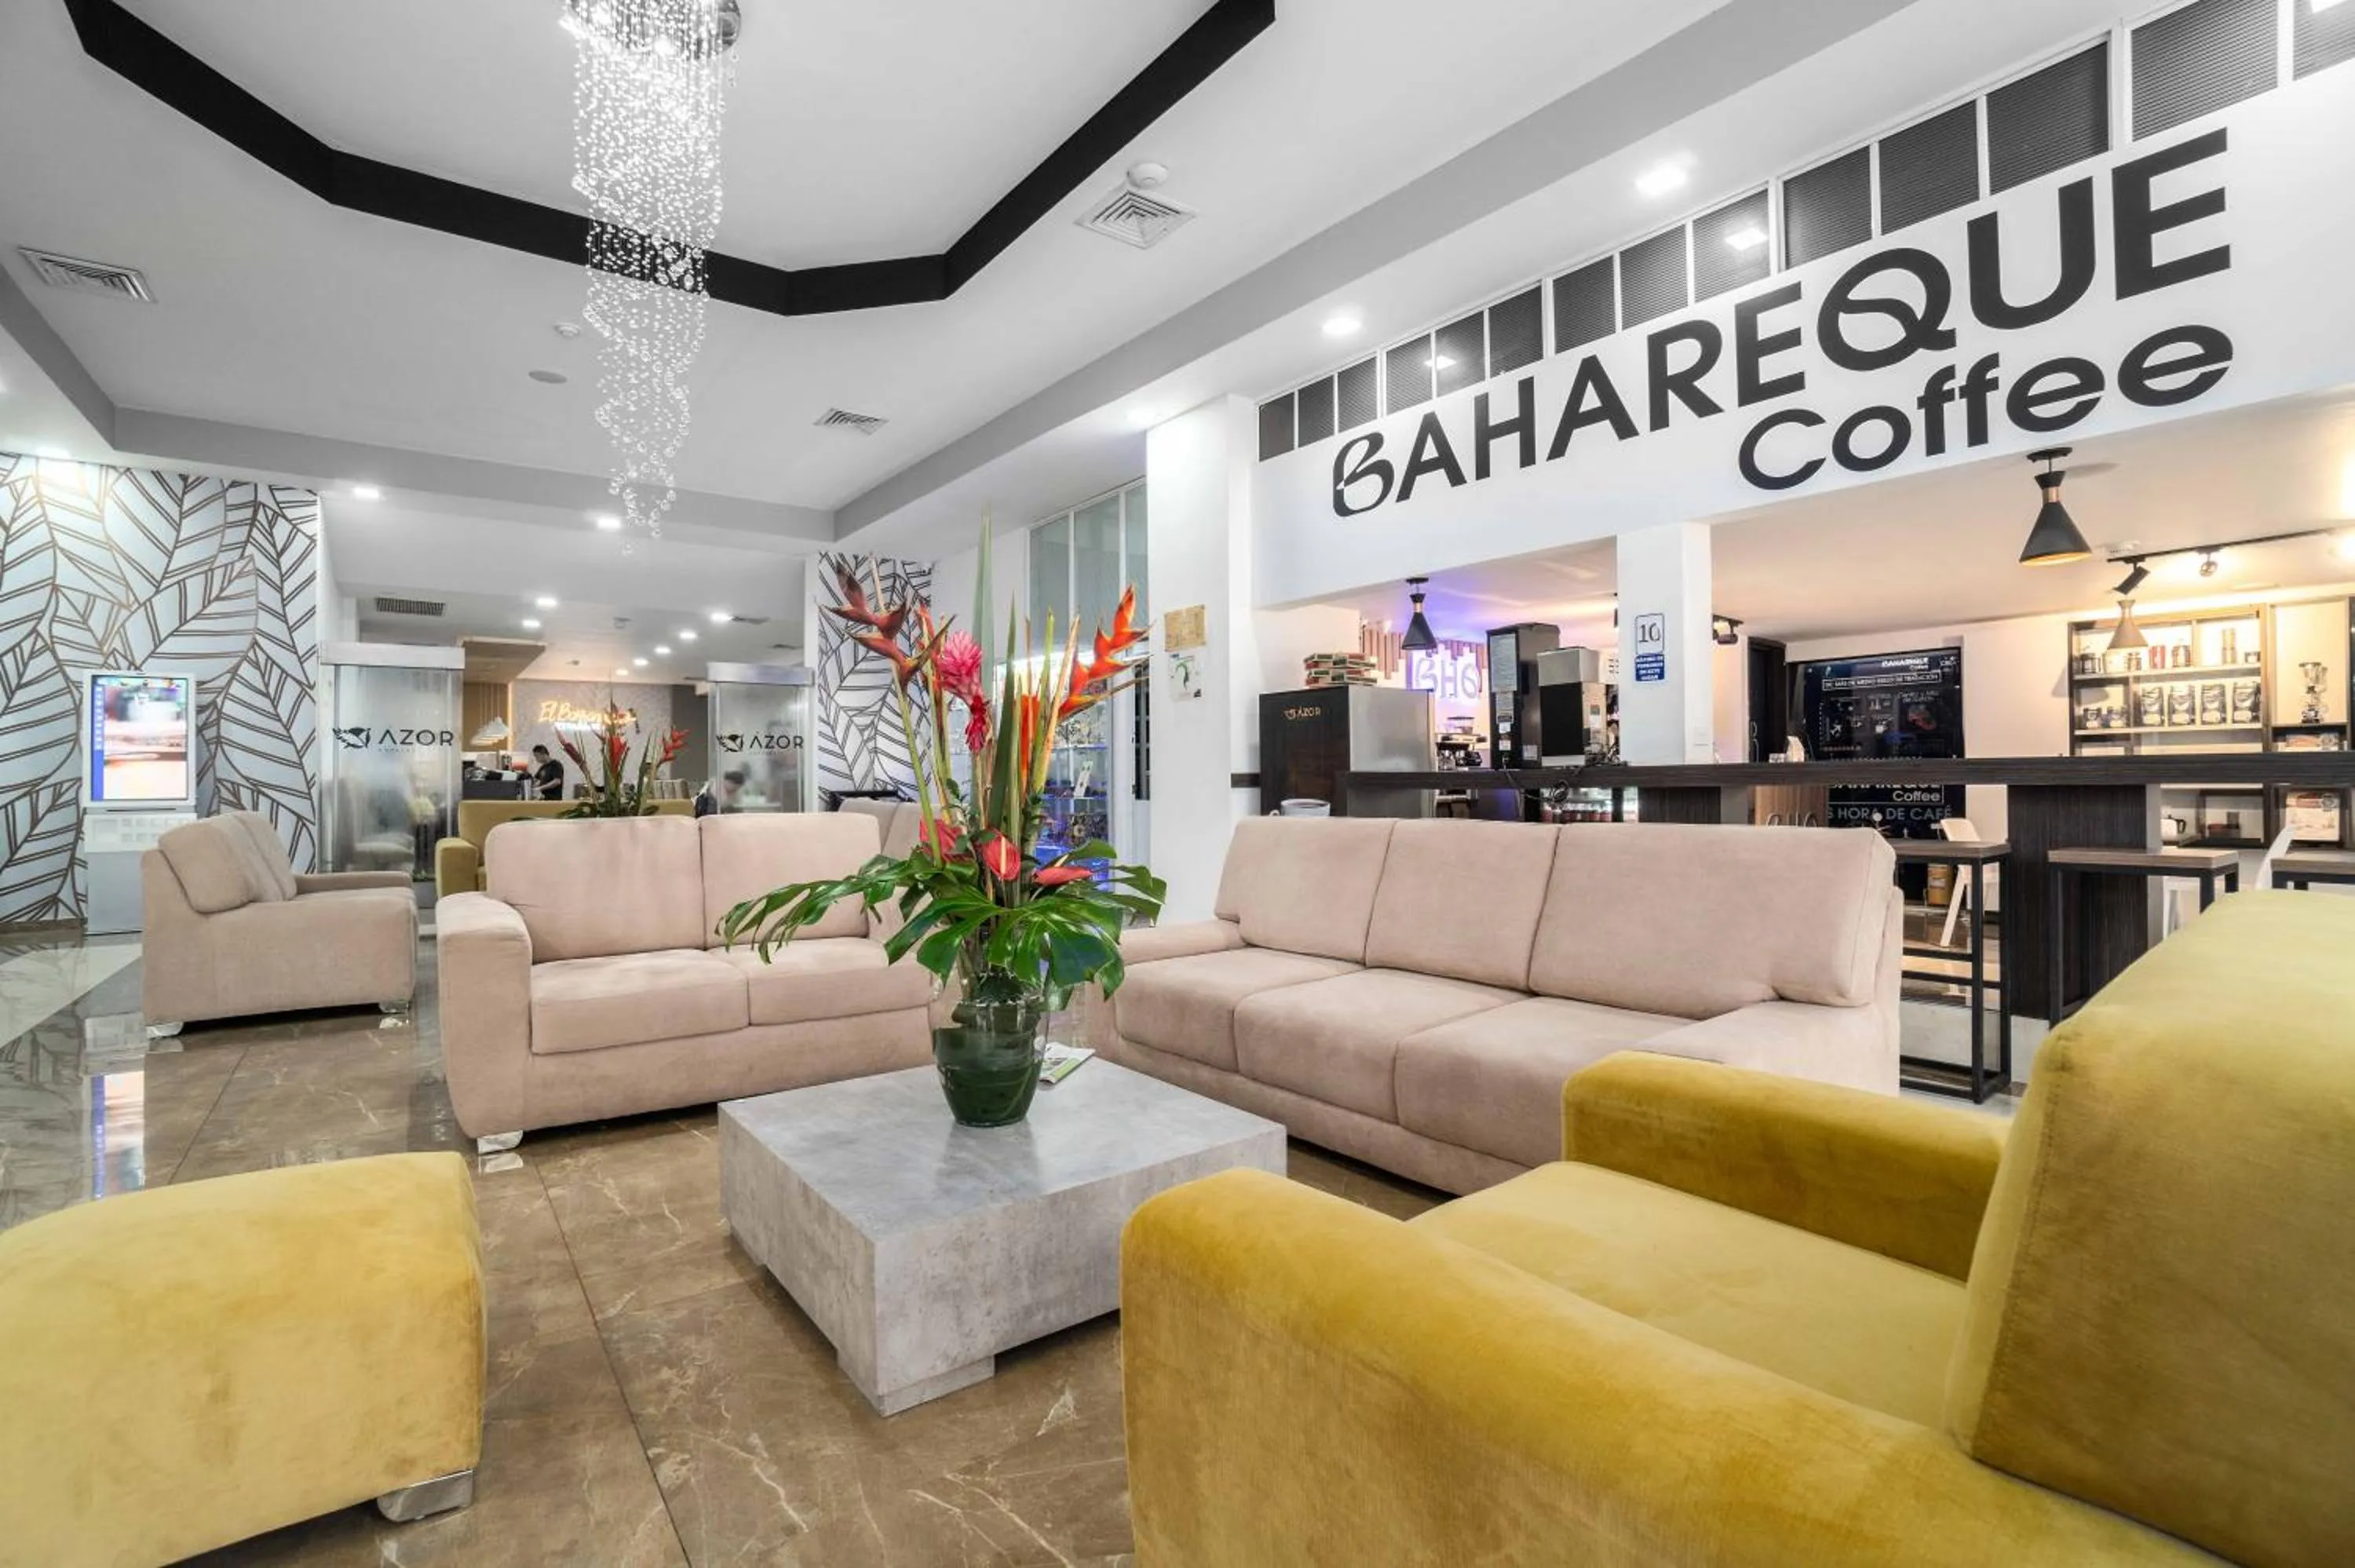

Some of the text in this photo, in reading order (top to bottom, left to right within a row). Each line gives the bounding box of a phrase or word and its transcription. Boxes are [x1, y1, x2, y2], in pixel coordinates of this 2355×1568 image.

[1332, 126, 2232, 518] BAHAREQUE
[1737, 324, 2234, 491] Coffee
[378, 729, 454, 746] AZOR
[750, 735, 805, 749] AZOR
[1893, 790, 1941, 801] Coffee
[1886, 808, 1905, 820] DE
[1910, 805, 1952, 820] CAFÉ
